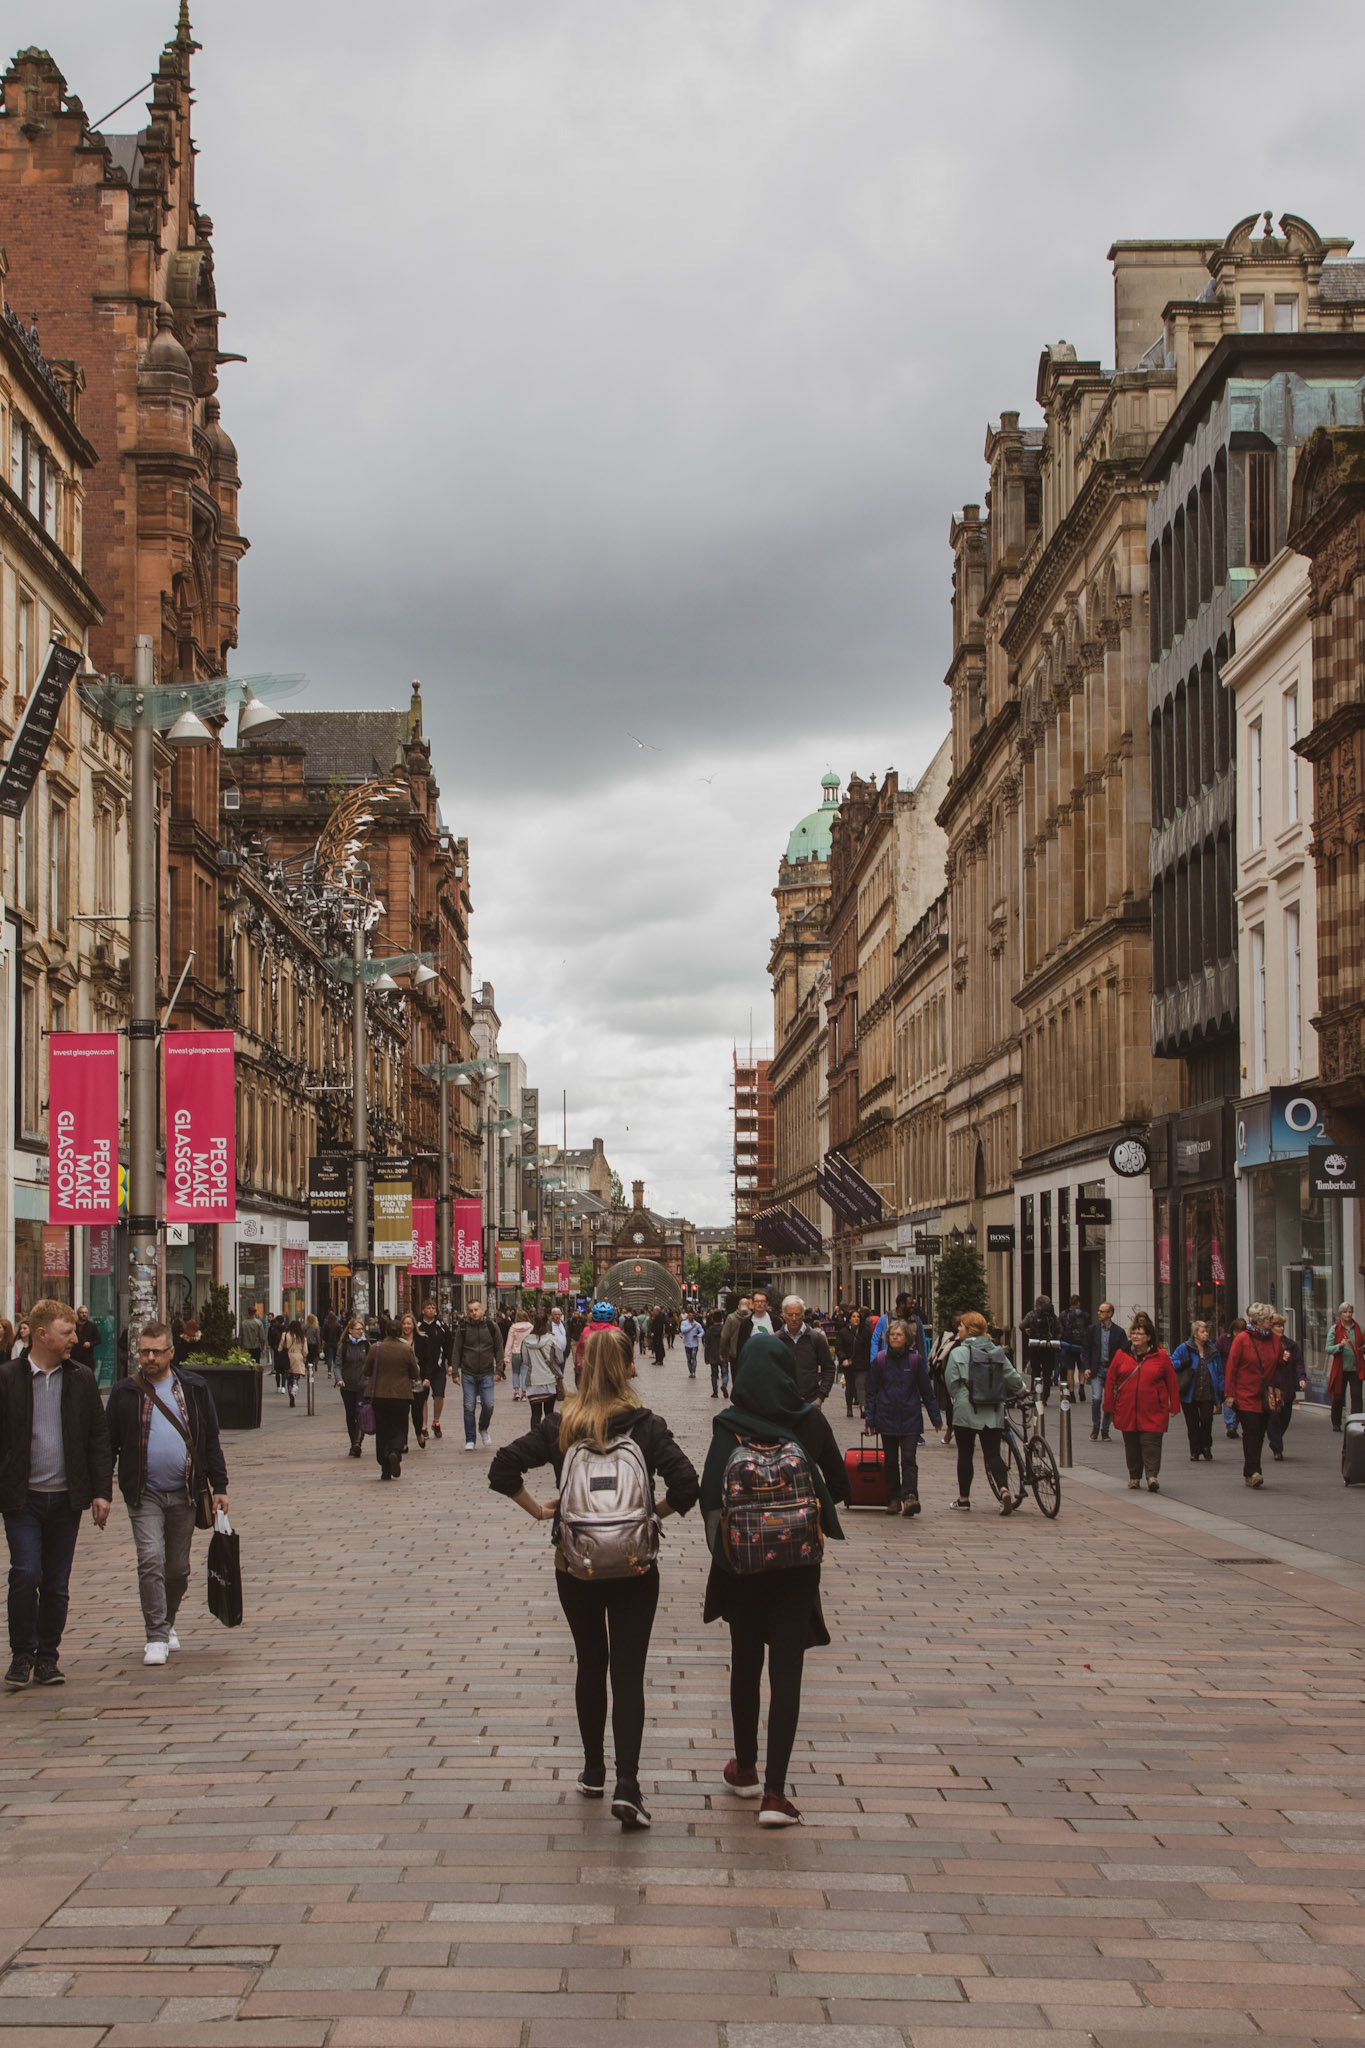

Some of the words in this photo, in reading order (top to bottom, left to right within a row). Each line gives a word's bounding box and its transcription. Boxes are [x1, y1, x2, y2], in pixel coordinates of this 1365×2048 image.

[524, 1095, 537, 1113] ST
[57, 1110, 75, 1209] GLASGOW
[93, 1139, 111, 1209] PEOPLE
[174, 1109, 192, 1208] GLASGOW
[210, 1137, 228, 1208] PEOPLE
[75, 1155, 92, 1210] MAKE
[192, 1152, 210, 1208] MAKE
[374, 1194, 412, 1202] GUINNESS
[1315, 1180, 1356, 1190] Timberland
[310, 1199, 346, 1207] PROUD
[425, 1240, 433, 1269] PEOPLE
[457, 1229, 465, 1269] GLASGOW
[471, 1240, 479, 1269] PEOPLE
